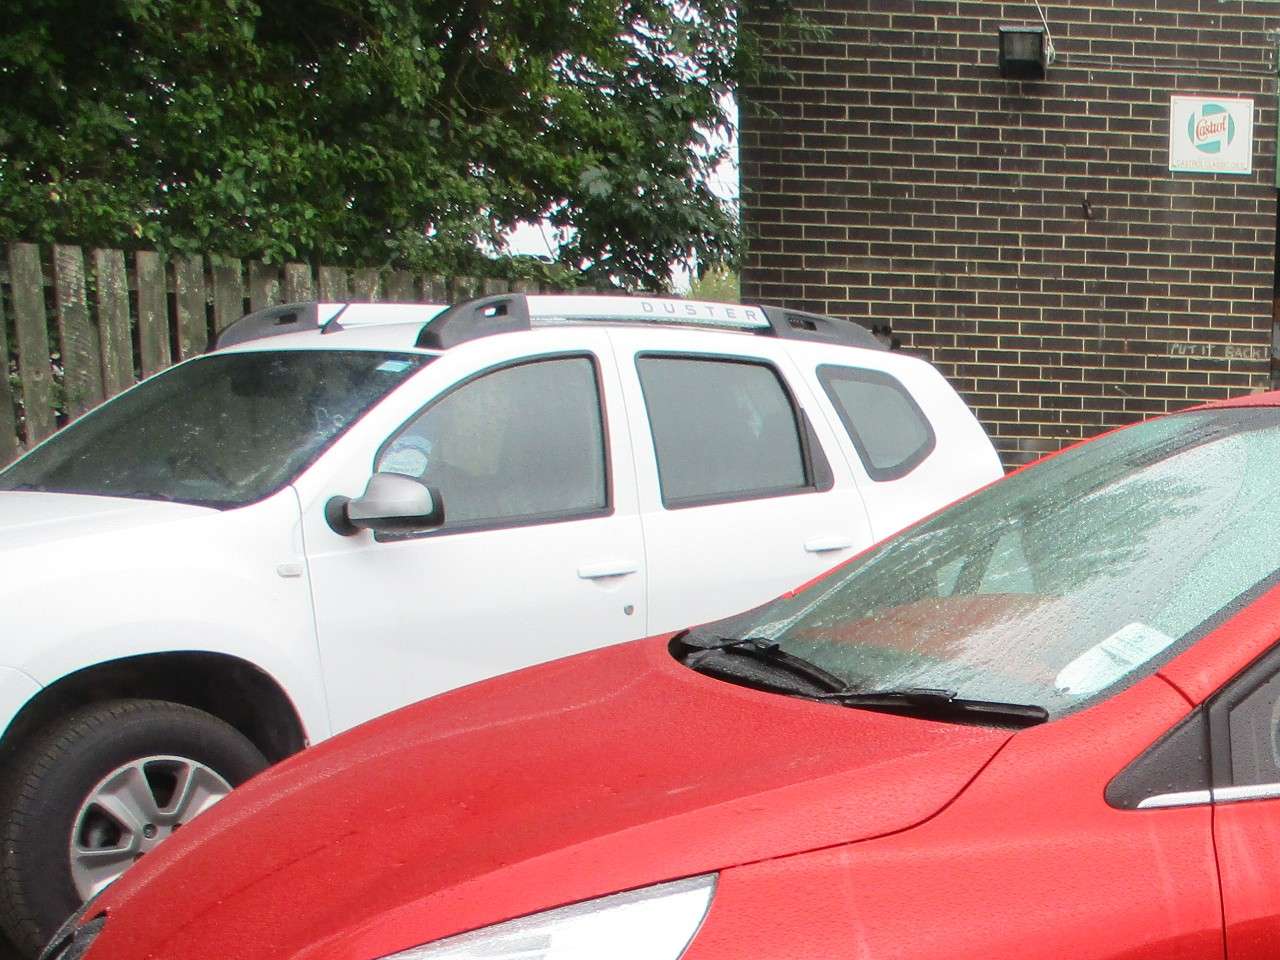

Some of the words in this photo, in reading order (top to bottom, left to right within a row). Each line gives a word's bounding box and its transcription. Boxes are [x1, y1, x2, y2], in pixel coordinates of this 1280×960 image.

[1196, 114, 1227, 141] Castrol
[641, 302, 757, 321] DUSTER
[1170, 343, 1198, 355] PUT
[1201, 344, 1216, 356] IT
